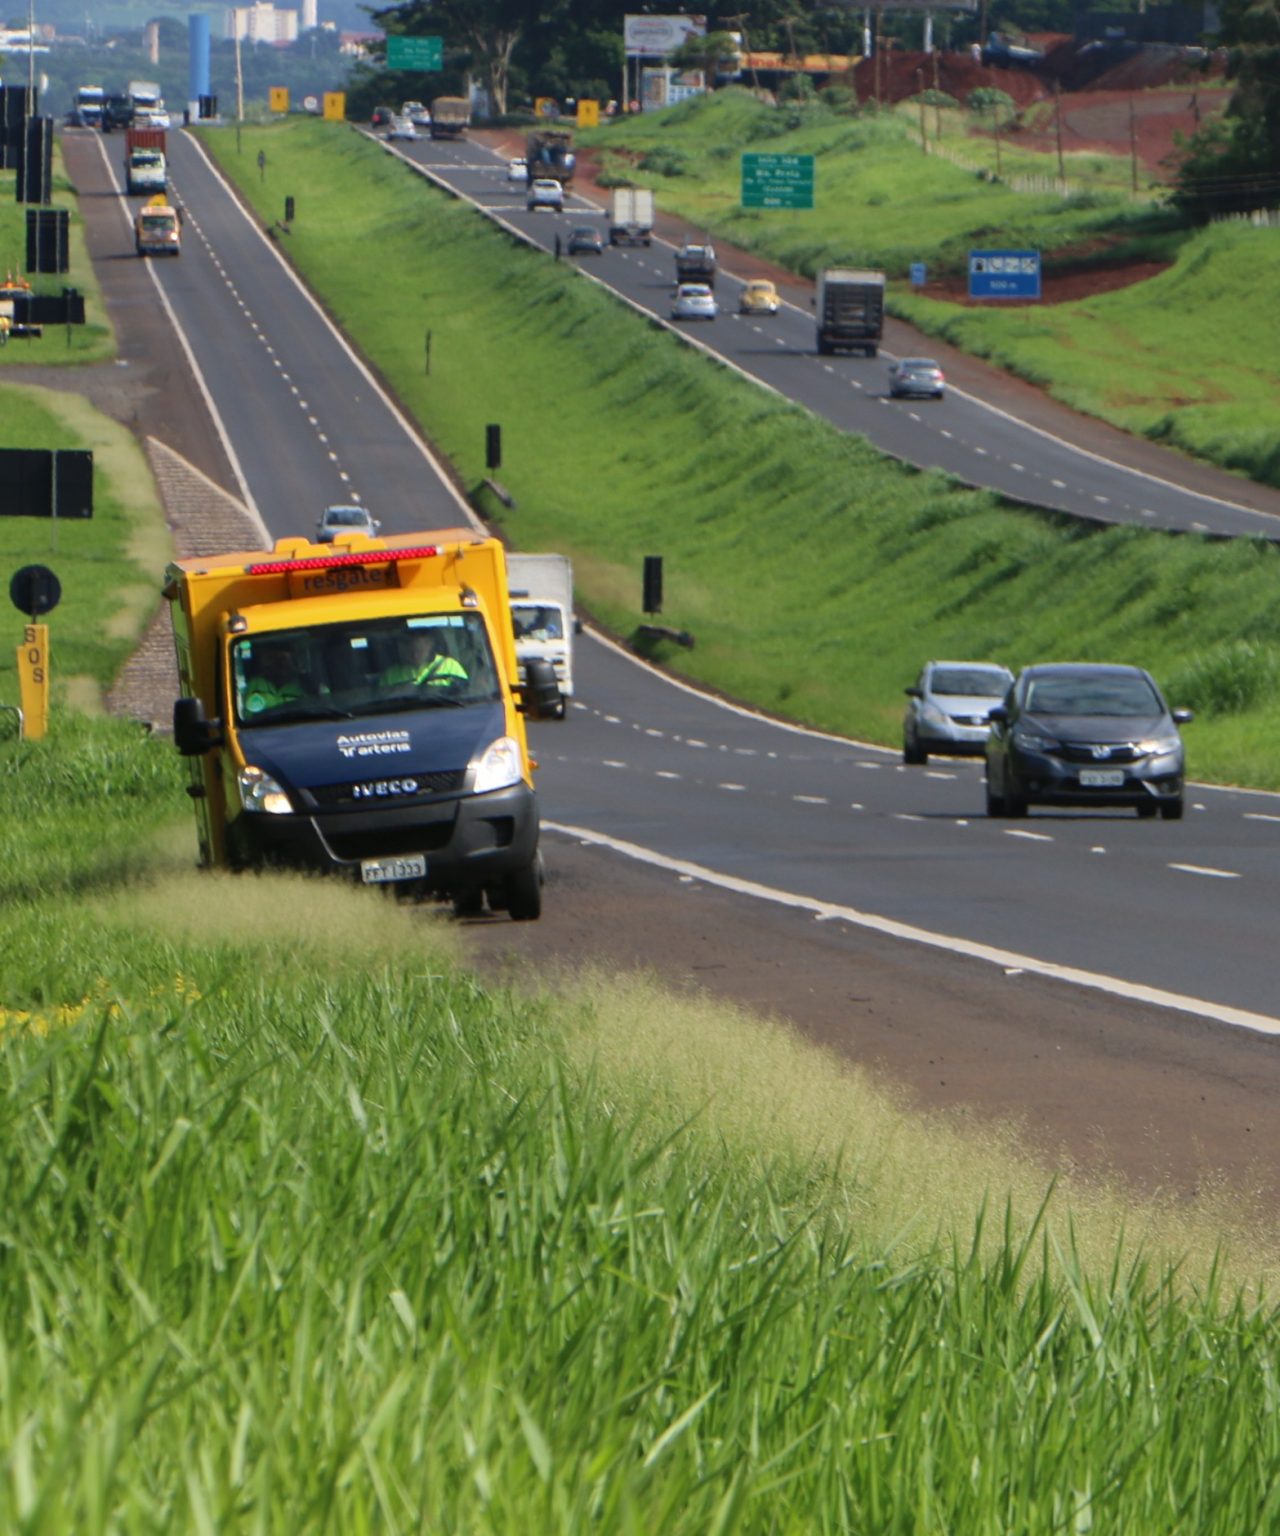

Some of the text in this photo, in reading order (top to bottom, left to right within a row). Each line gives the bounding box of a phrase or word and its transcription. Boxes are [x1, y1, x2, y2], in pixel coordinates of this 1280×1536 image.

[303, 567, 382, 592] resgate
[24, 626, 45, 685] SOS
[337, 730, 410, 748] Autovias
[358, 743, 412, 757] arteris
[353, 779, 418, 799] IVECO
